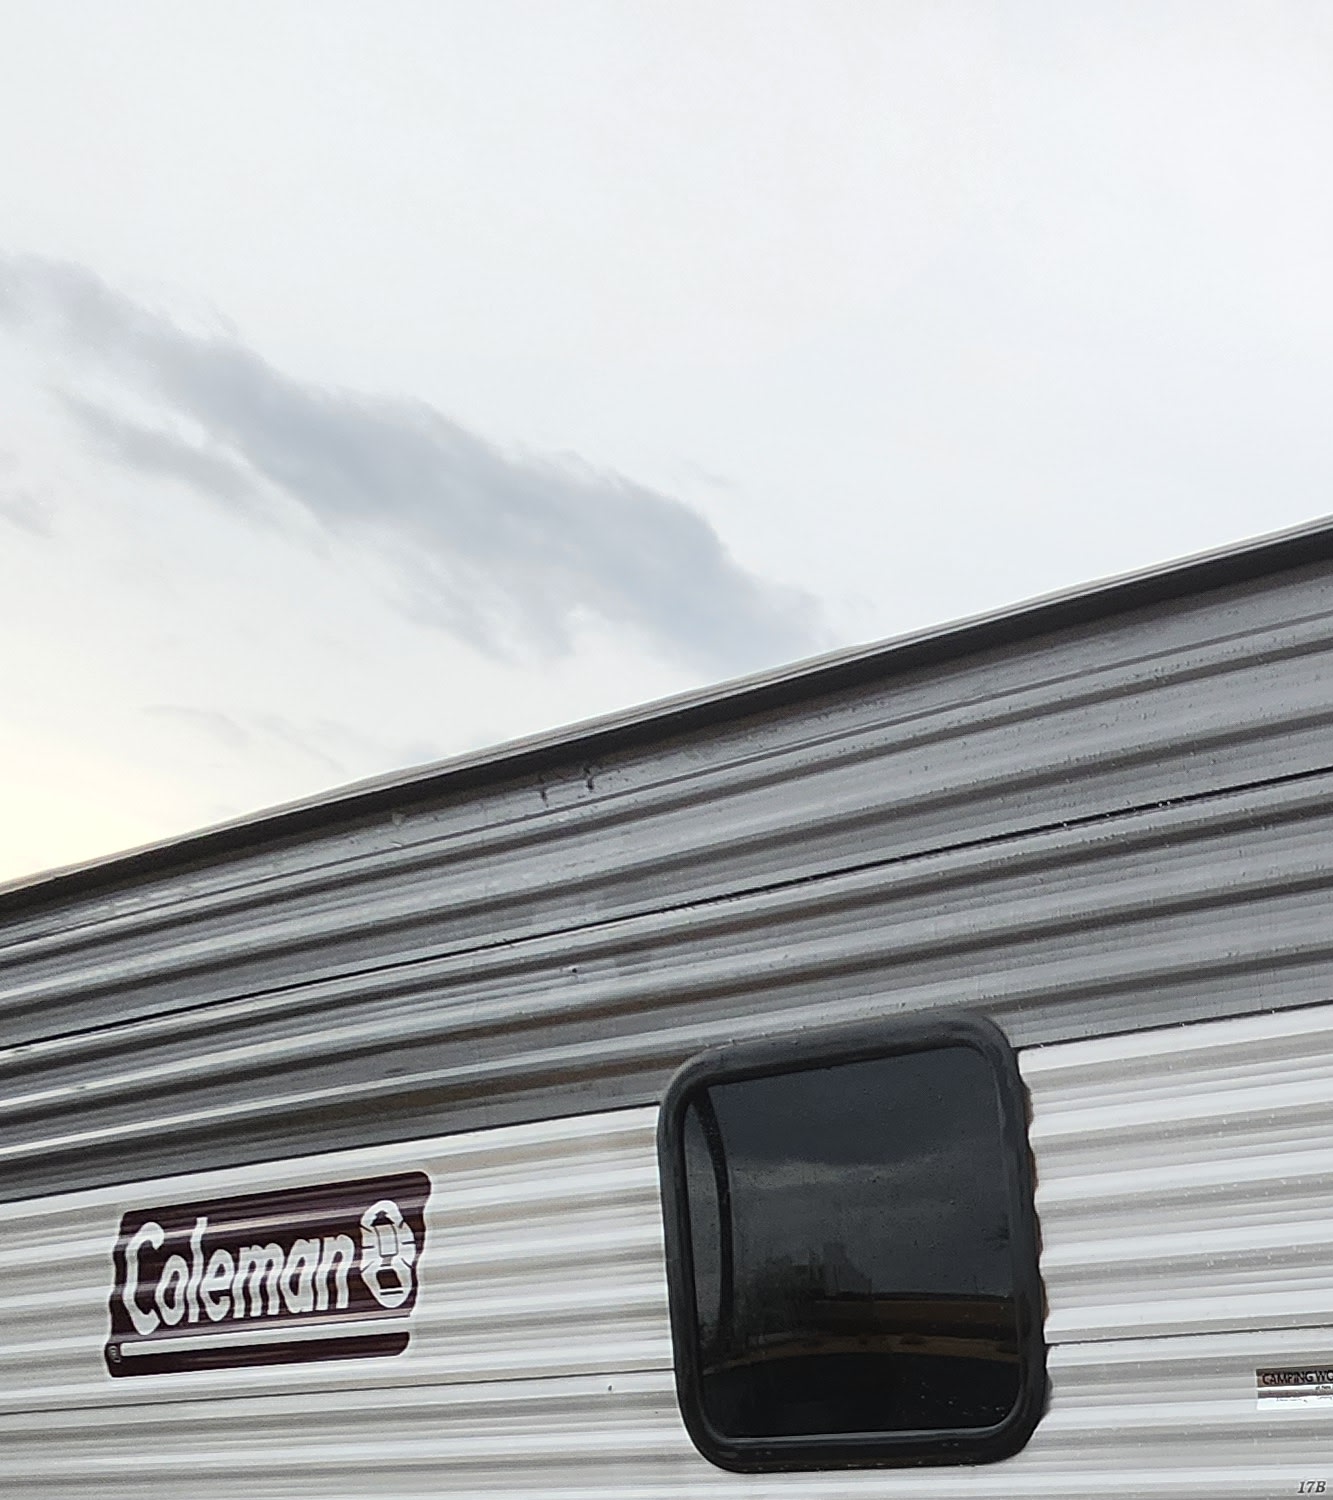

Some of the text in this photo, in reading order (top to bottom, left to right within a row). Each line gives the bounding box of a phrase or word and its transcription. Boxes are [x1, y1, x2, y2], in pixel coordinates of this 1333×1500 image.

[123, 1216, 355, 1335] Coleman
[1262, 1370, 1314, 1385] CAMPING
[1297, 1480, 1326, 1493] 17B
